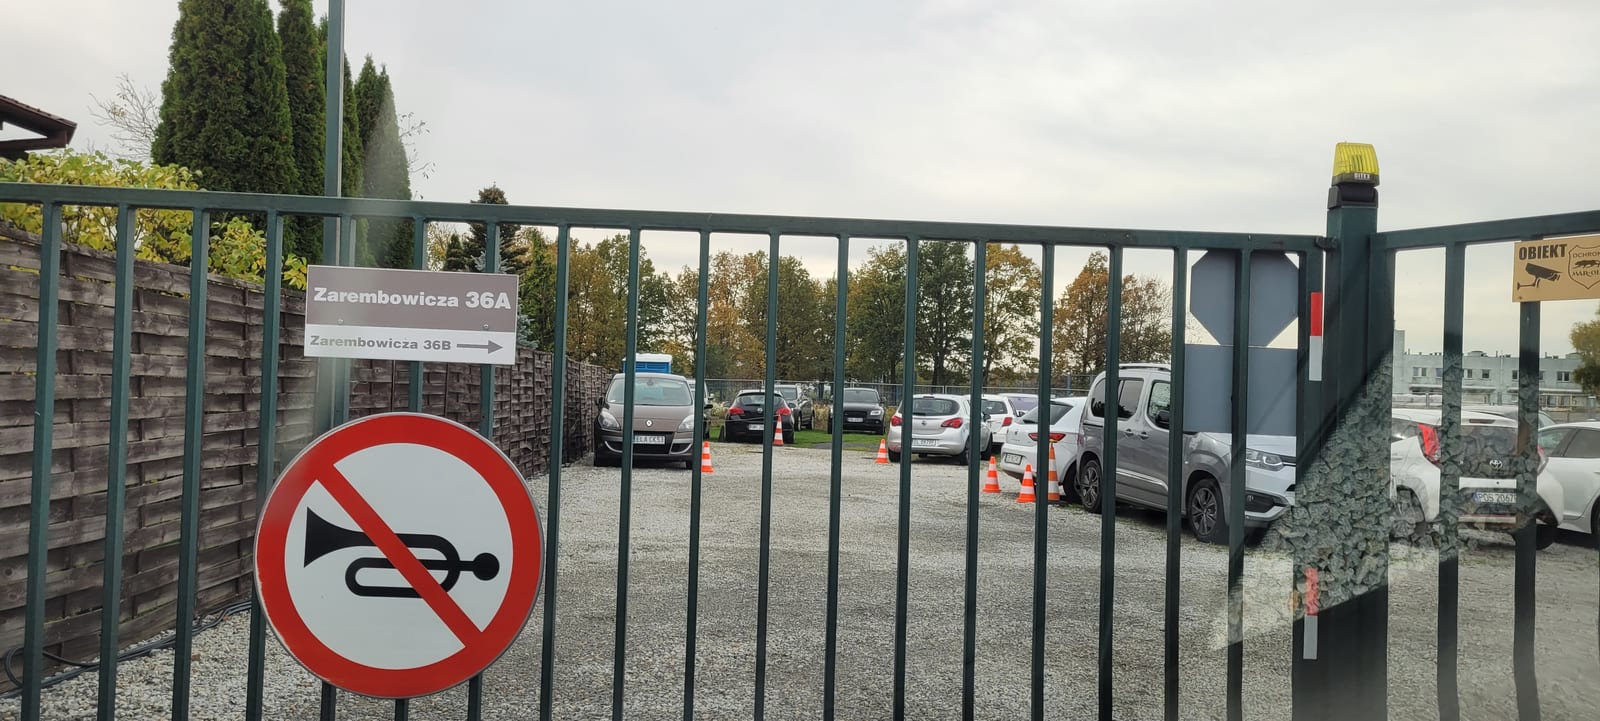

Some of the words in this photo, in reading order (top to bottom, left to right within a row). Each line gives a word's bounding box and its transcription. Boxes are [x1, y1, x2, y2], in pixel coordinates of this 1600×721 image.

[1519, 244, 1567, 260] OBIEKT
[313, 287, 459, 307] Zarembowicza
[465, 291, 512, 309] 36A
[310, 335, 418, 349] Zarembowicza
[423, 340, 451, 350] 36B
